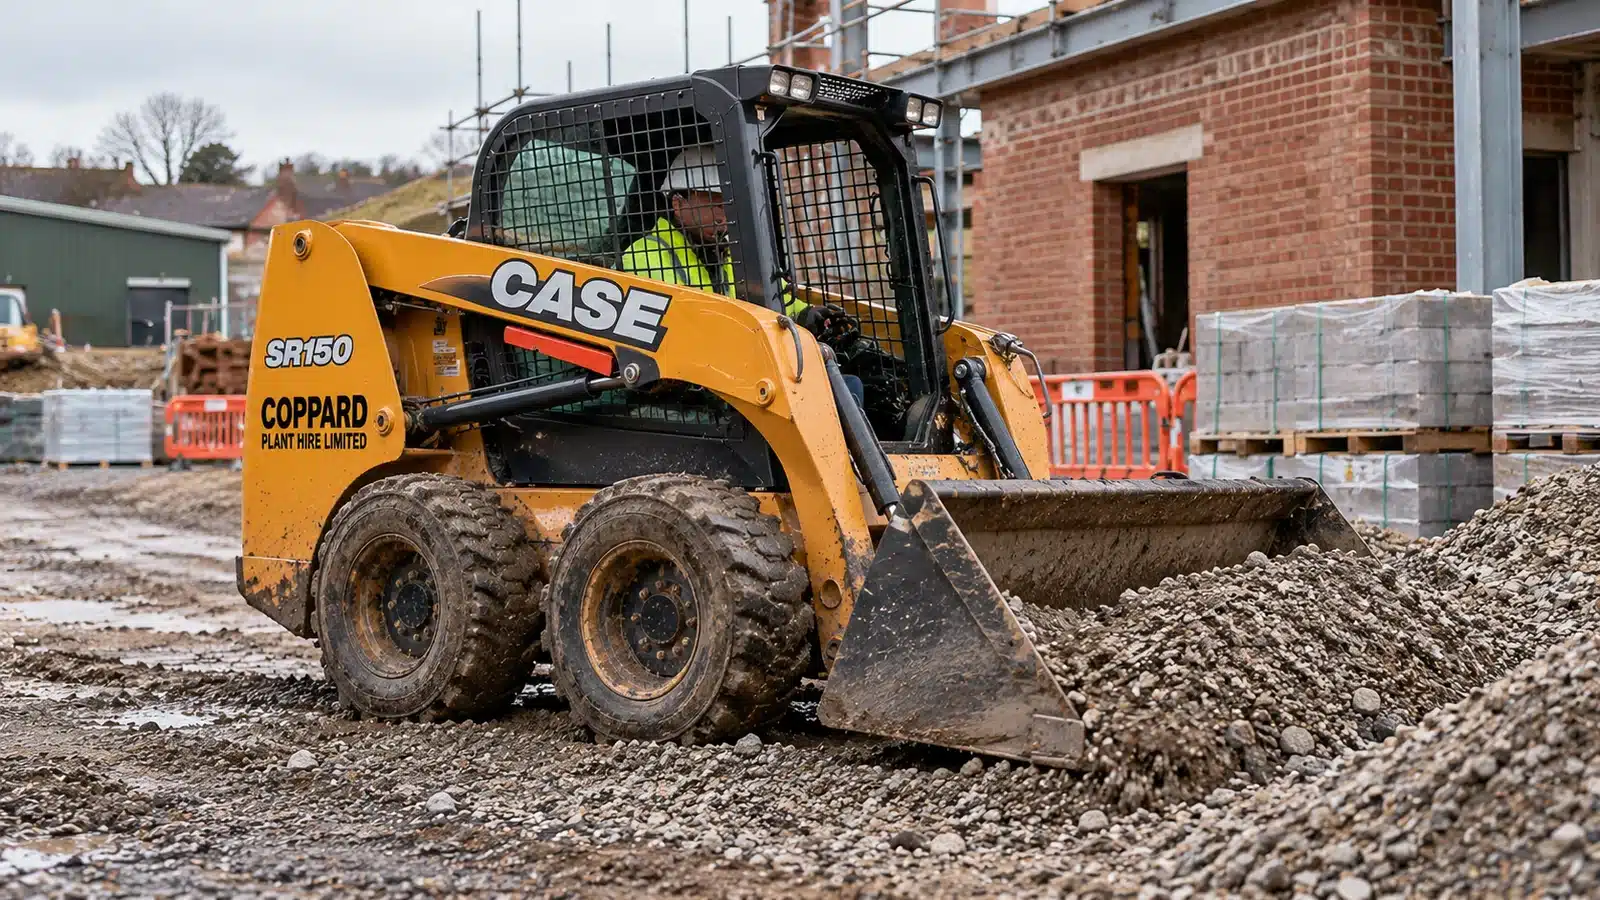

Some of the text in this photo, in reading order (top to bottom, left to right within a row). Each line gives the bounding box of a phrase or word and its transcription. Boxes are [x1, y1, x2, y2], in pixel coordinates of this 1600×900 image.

[490, 258, 671, 345] CASE
[265, 334, 353, 368] SR150
[261, 395, 368, 429] COPPARD
[261, 432, 367, 450] PLANT HIRE LIMITED
